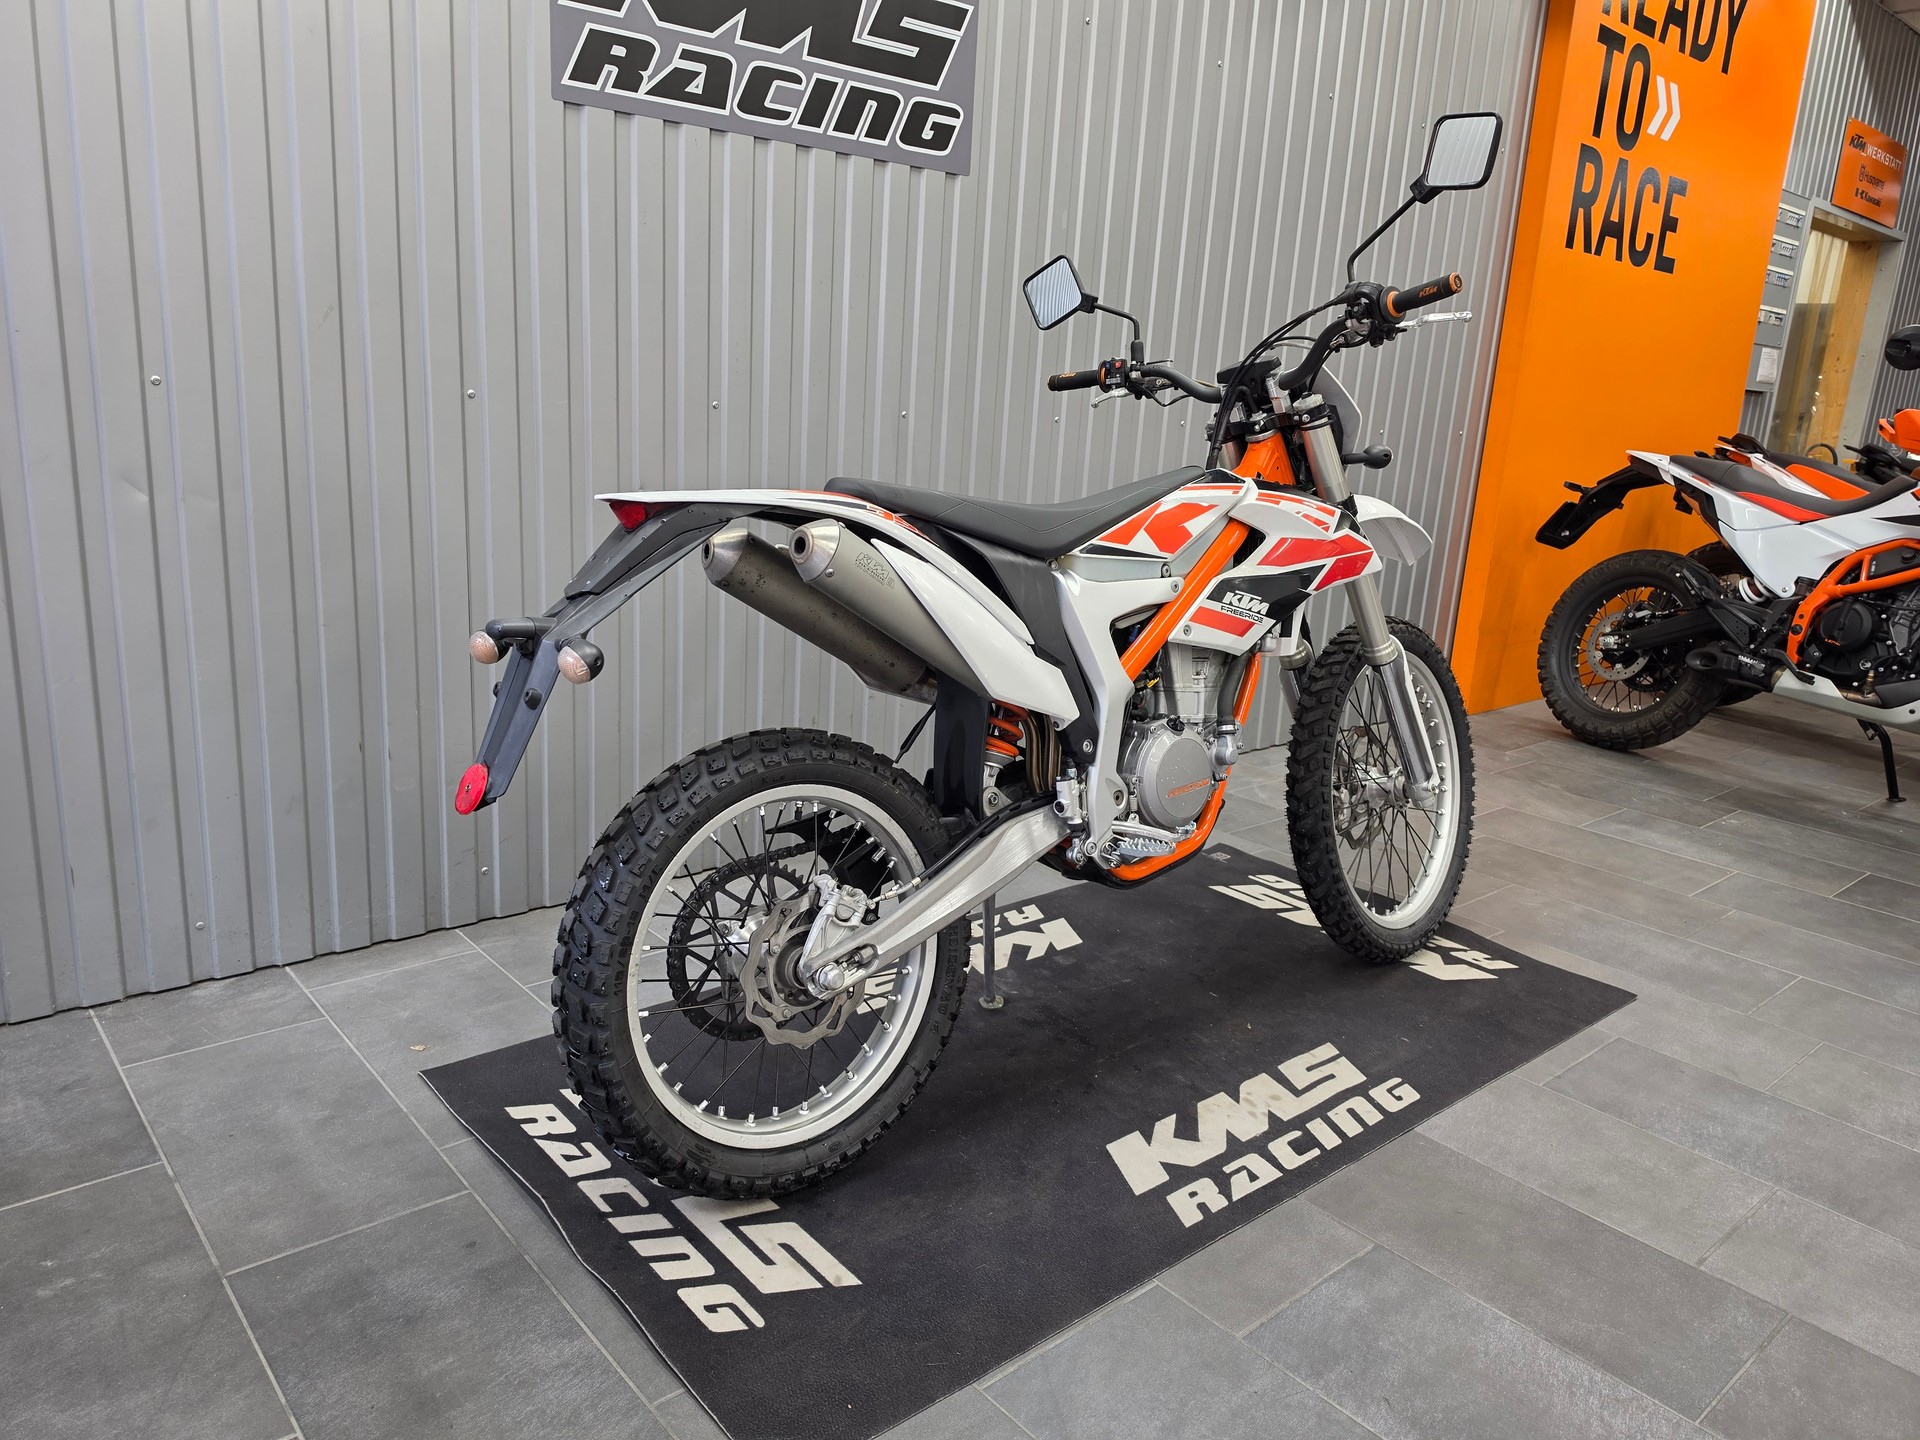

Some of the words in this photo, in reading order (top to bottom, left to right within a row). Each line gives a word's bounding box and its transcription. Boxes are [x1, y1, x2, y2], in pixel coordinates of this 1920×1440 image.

[561, 22, 964, 156] RACING
[1592, 22, 1651, 151] TO
[1564, 142, 1689, 275] RACE
[1220, 605, 1264, 624] FREERIDE
[1221, 590, 1270, 616] KTM
[1105, 1041, 1368, 1197] KMS
[1165, 1076, 1421, 1229] RACING
[503, 1102, 766, 1334] RACING
